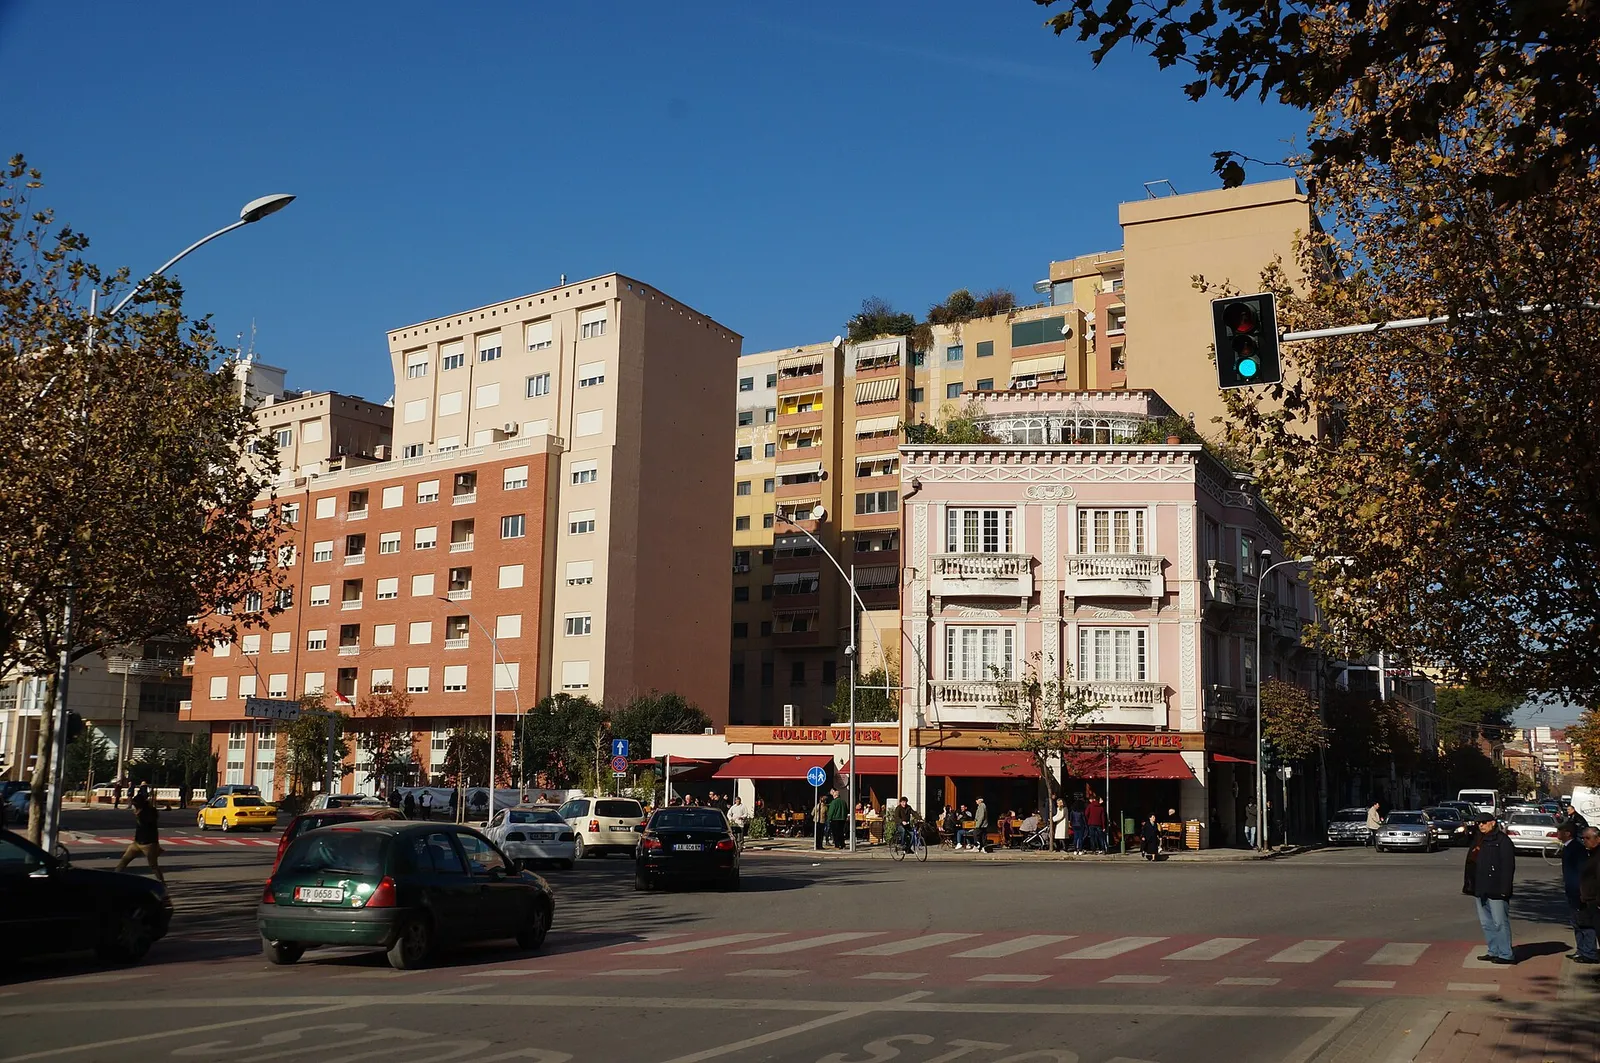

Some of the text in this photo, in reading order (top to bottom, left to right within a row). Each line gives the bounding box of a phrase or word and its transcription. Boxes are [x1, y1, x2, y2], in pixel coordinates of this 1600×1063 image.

[772, 729, 827, 742] MULLIRI
[1126, 734, 1184, 749] VJETER
[302, 888, 341, 899] TR 0658 S
